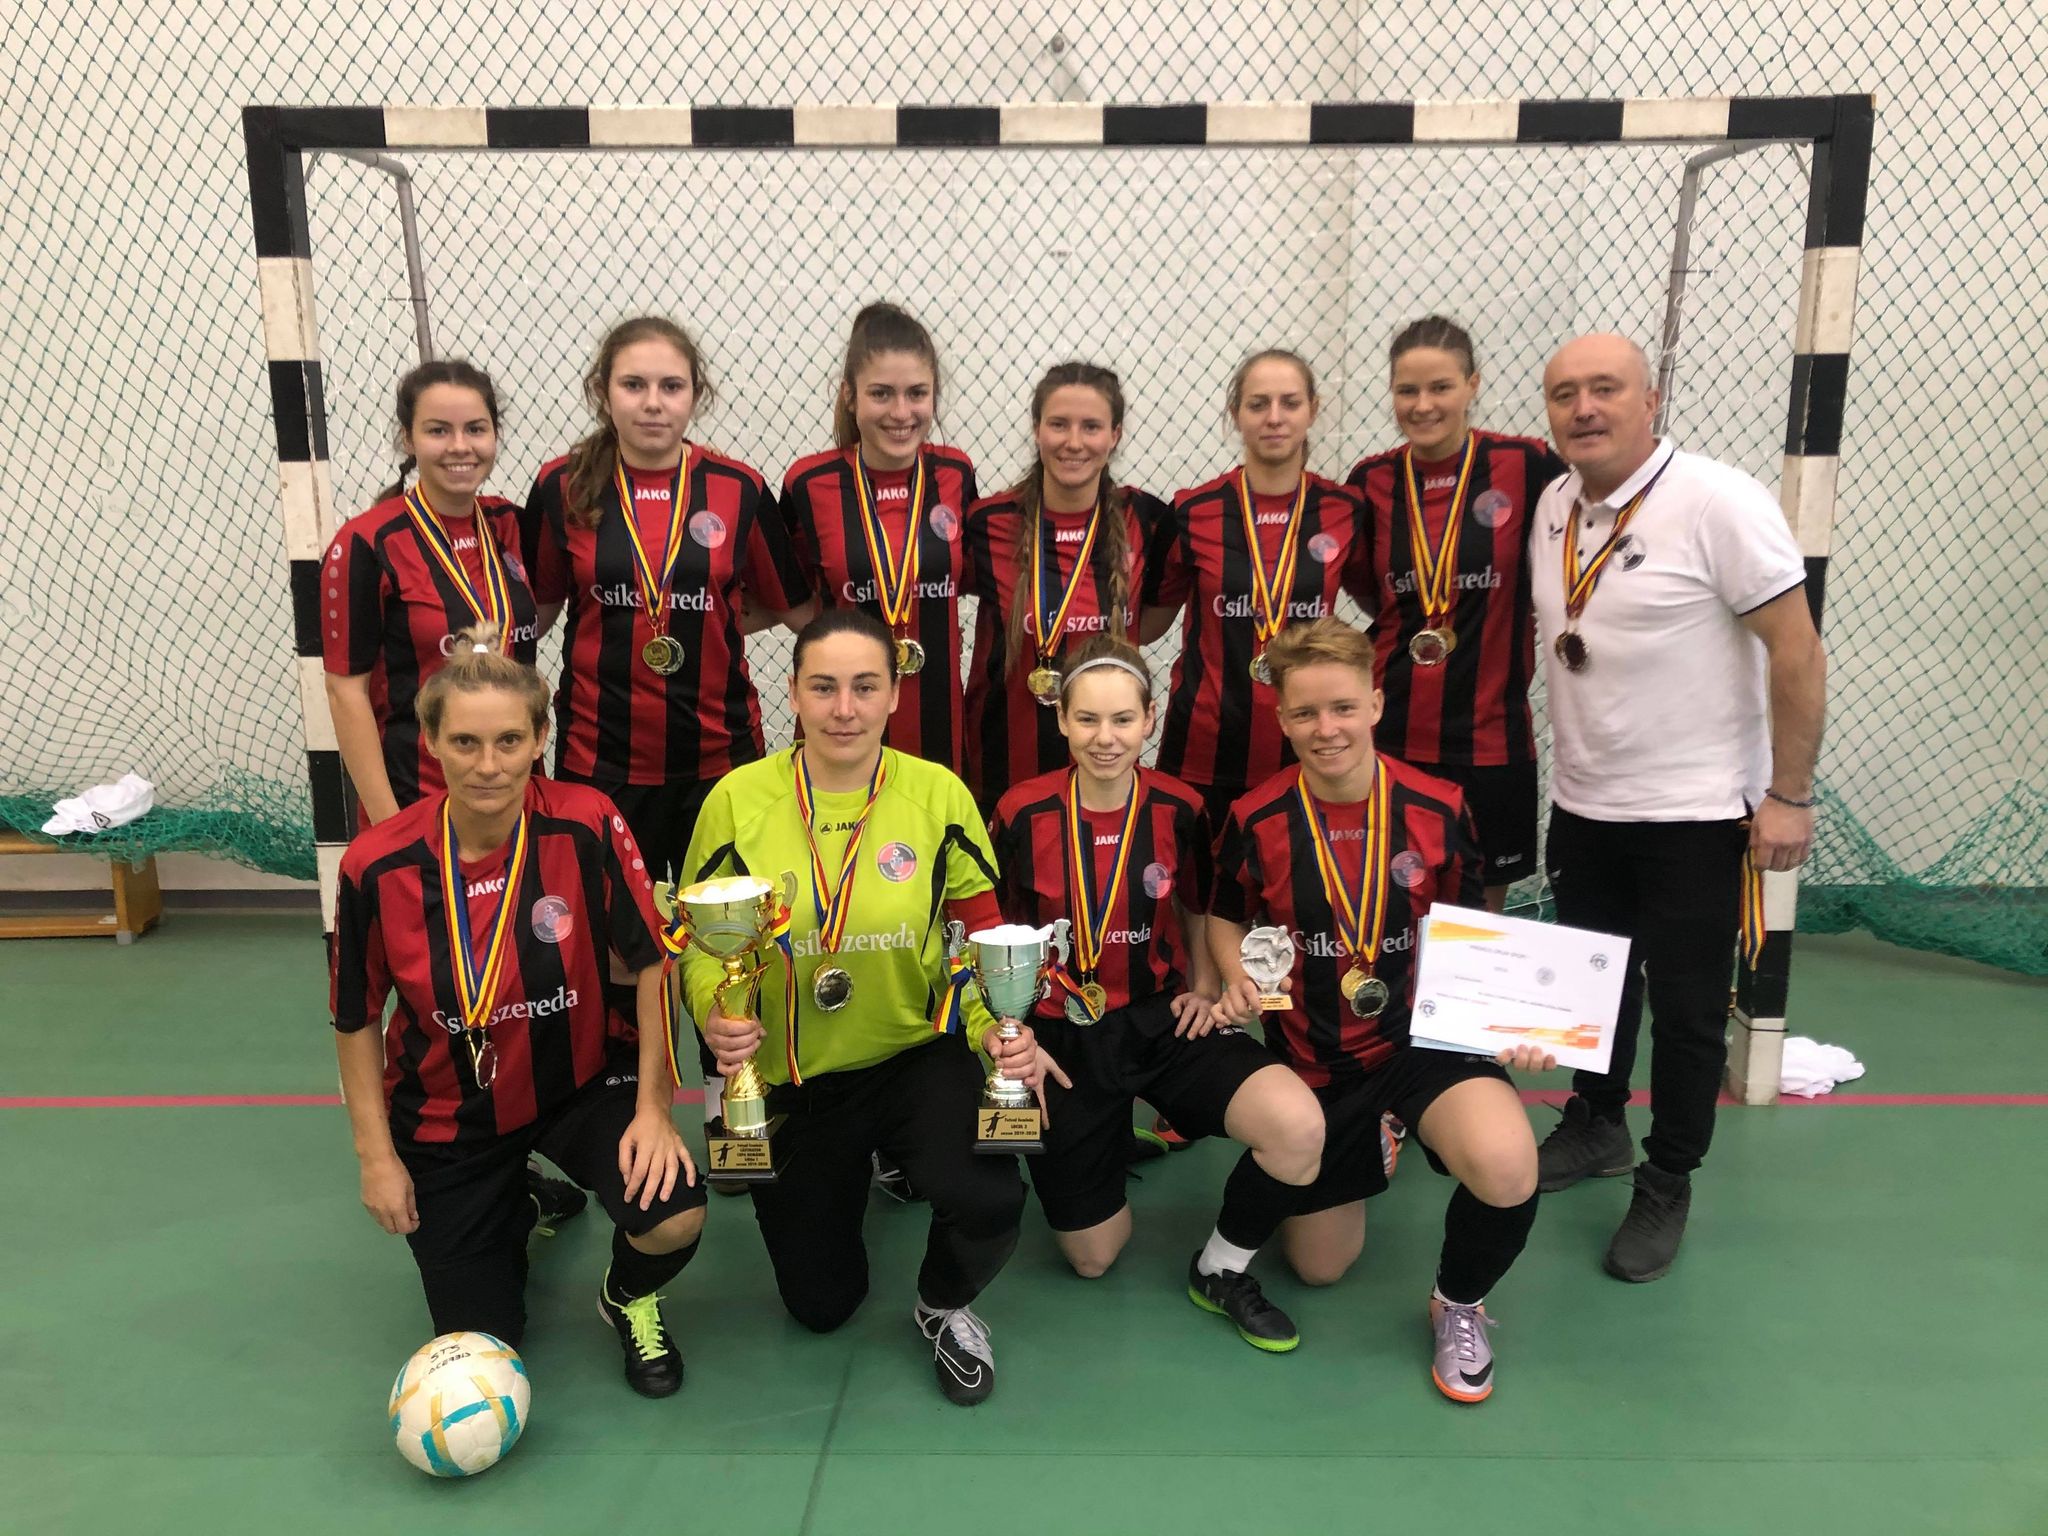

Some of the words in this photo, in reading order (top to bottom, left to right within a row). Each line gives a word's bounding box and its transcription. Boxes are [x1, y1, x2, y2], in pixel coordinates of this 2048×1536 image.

[1424, 476, 1457, 490] JAKO
[635, 488, 670, 501] JAKO
[877, 487, 908, 501] JAKO
[1256, 512, 1289, 525] JAKO
[1056, 529, 1085, 542] JAKO
[453, 537, 478, 551] JAKO
[843, 574, 955, 603] Csíereda
[590, 583, 714, 612] Csíksreda
[1213, 594, 1329, 618] Csíkreda
[835, 821, 856, 831] JAK
[1329, 829, 1364, 841] JAKO
[467, 878, 505, 898] JAKO
[432, 985, 579, 1034] Csszereda
